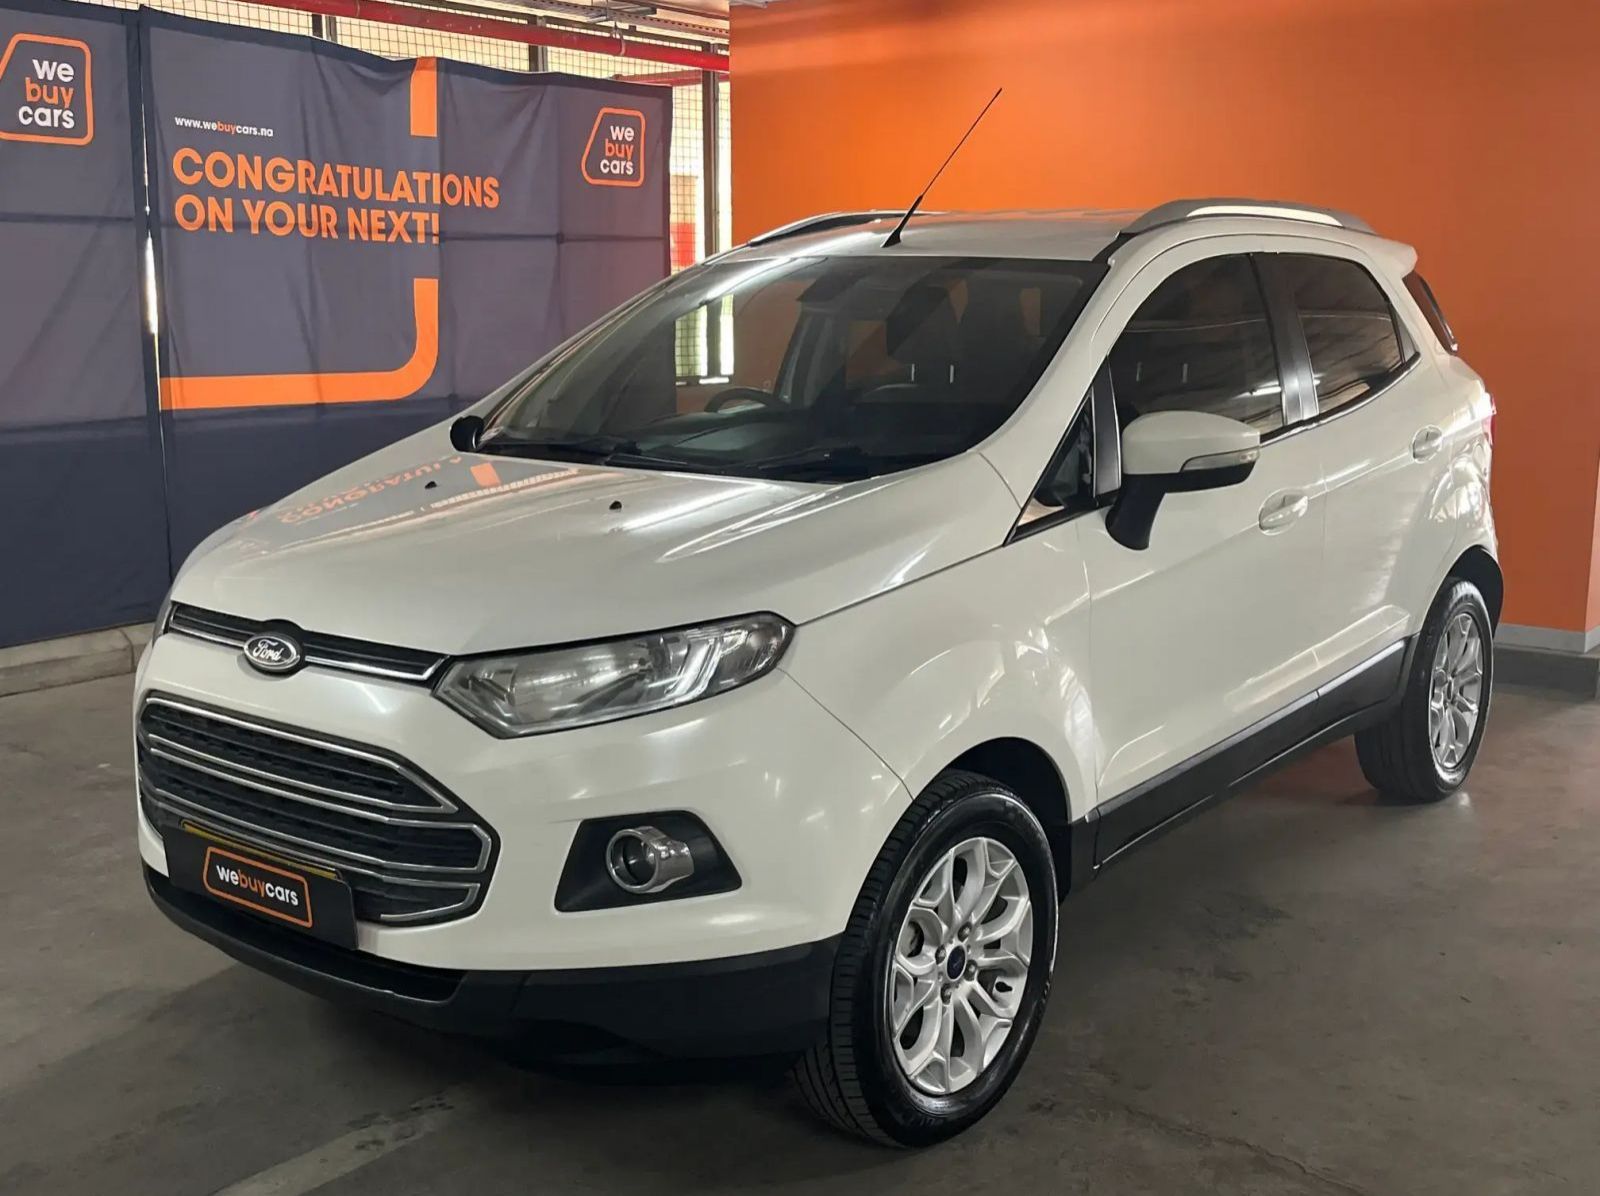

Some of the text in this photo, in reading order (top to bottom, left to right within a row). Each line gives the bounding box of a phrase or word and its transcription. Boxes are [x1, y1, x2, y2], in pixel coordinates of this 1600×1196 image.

[32, 59, 75, 83] we
[25, 77, 74, 109] buy
[18, 105, 75, 129] cars
[174, 116, 274, 138] www.webuycars.na
[610, 125, 635, 142] we
[605, 138, 634, 161] buy
[172, 147, 500, 209] CONGRATULATIONS
[600, 159, 634, 176] cars
[174, 194, 441, 246] ON YOUR NEXT!
[252, 638, 285, 662] Ford
[216, 864, 299, 907] webuycars
